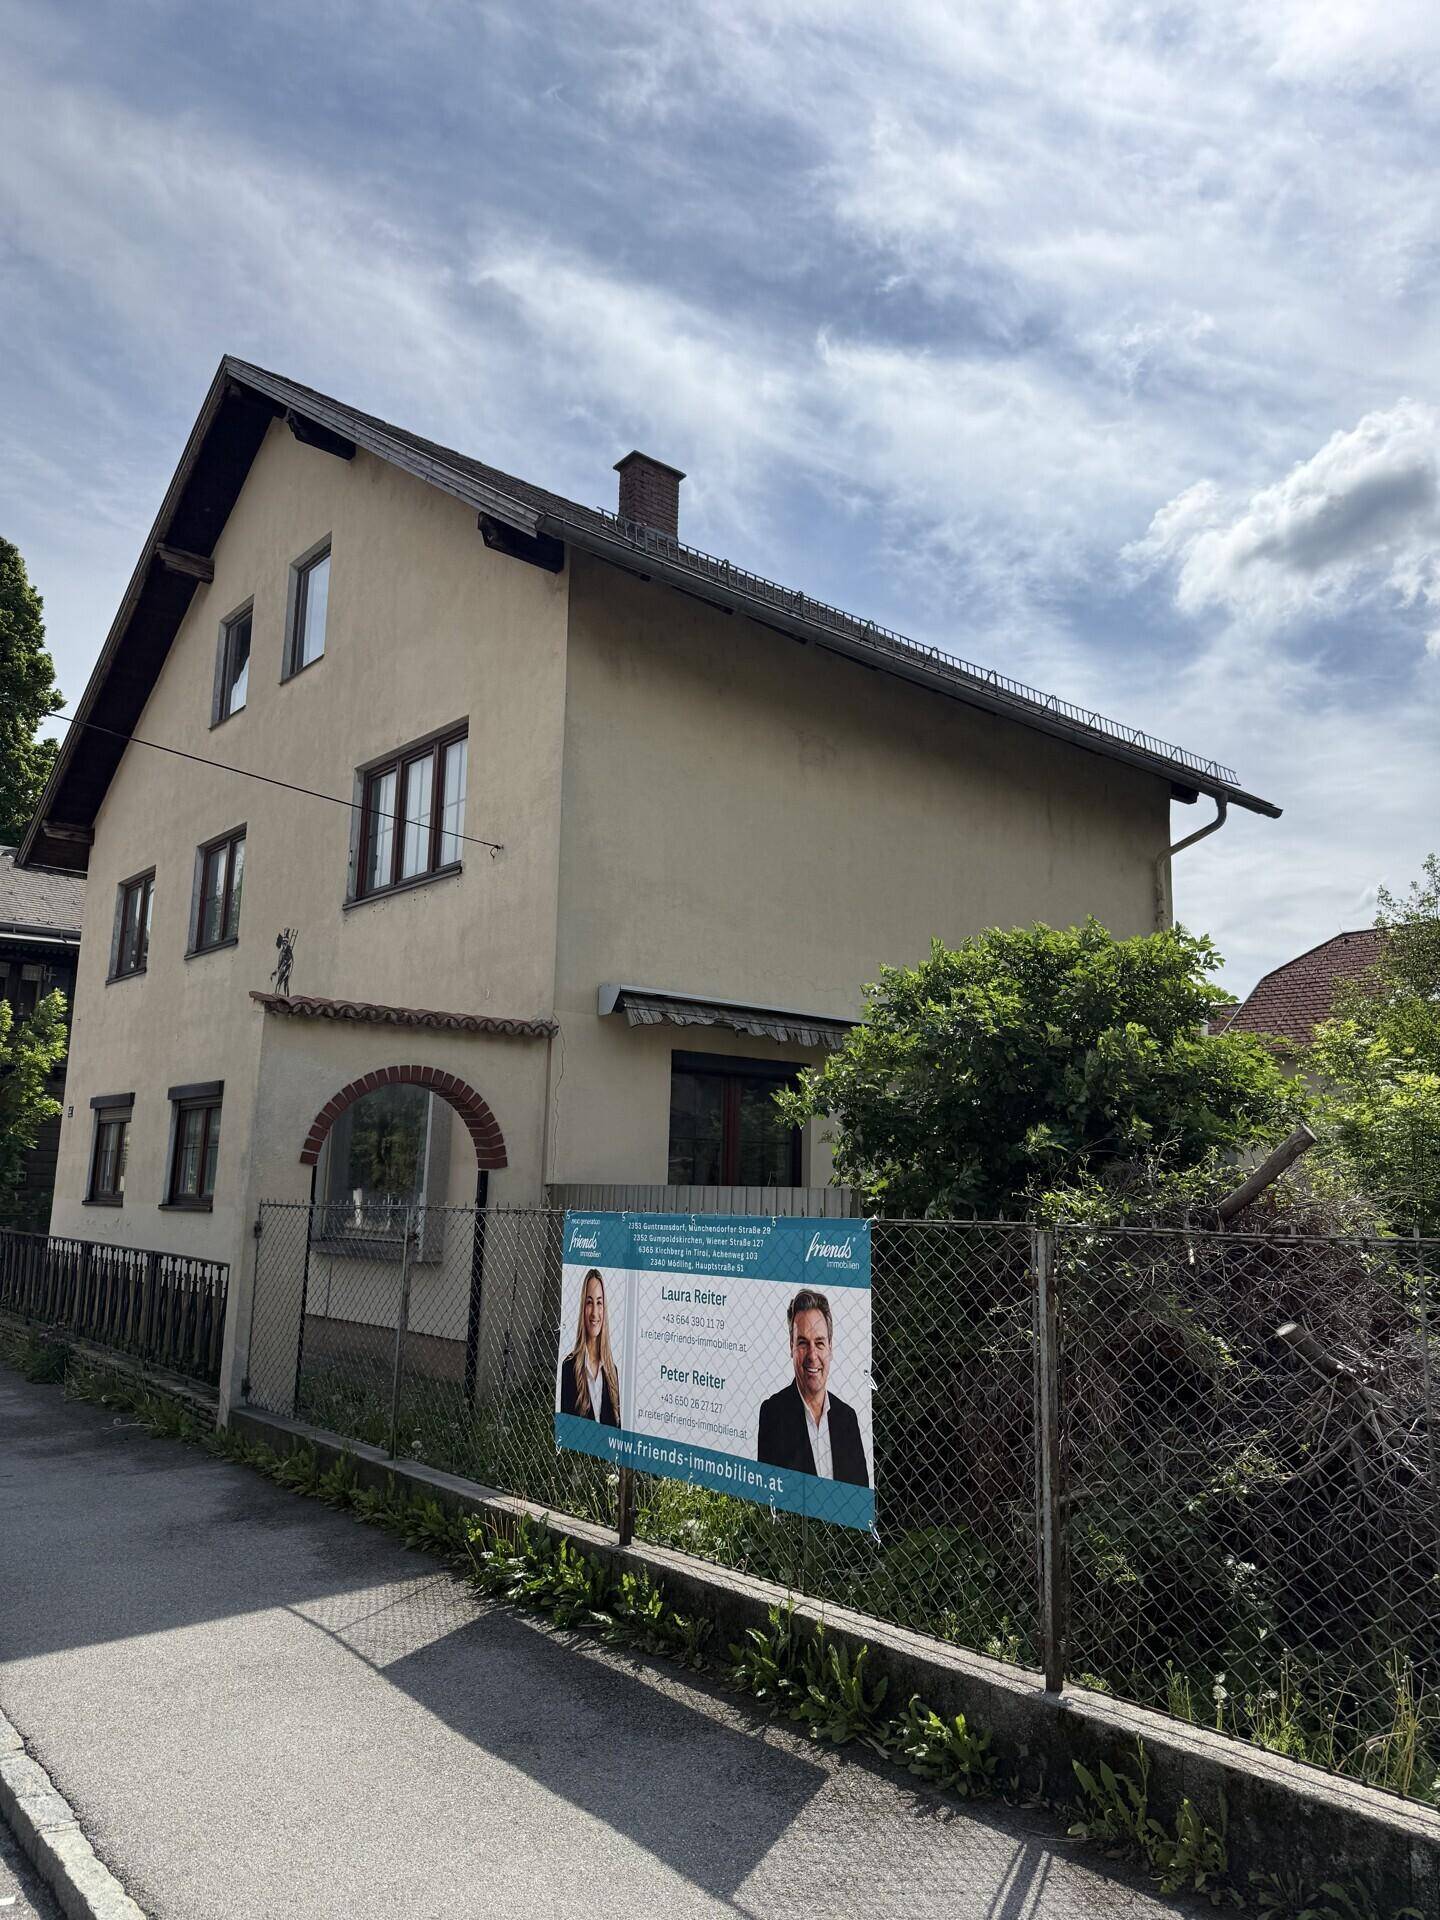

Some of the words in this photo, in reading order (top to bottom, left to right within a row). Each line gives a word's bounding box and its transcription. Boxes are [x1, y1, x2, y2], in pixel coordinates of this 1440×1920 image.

[643, 1223, 687, 1232] Guntramsdorf,
[738, 1226, 761, 1234] Straße
[568, 1227, 598, 1253] friends
[633, 1234, 648, 1242] 2352
[649, 1235, 705, 1246] Gumpoldskirchen,
[706, 1238, 729, 1246] Wiener
[730, 1238, 751, 1247] Straße
[752, 1239, 764, 1247] 127
[804, 1231, 852, 1263] friends
[655, 1247, 684, 1257] Kirchberg
[694, 1249, 711, 1258] Tirol,
[712, 1250, 745, 1261] Achenweg
[746, 1252, 758, 1260] 103
[650, 1258, 666, 1266] 2340
[667, 1259, 694, 1269] Mödling,
[696, 1262, 736, 1272] Hauptstraße
[737, 1264, 744, 1272] 51
[826, 1259, 860, 1270] immobilien
[661, 1286, 691, 1303] Laura
[694, 1289, 727, 1306] Reiter
[662, 1313, 675, 1325] +43
[676, 1314, 690, 1326] 664
[691, 1316, 705, 1328] 390
[706, 1318, 714, 1329] 11
[715, 1319, 725, 1330] 79
[660, 1365, 690, 1383] Peter
[692, 1370, 726, 1390] Reiter
[661, 1393, 673, 1405] +43
[674, 1395, 688, 1407] 650
[690, 1398, 700, 1409] 26
[700, 1400, 709, 1411] 27
[710, 1402, 723, 1414] 127
[637, 1408, 748, 1440] p.reiter@friends-immobilien.at
[608, 1436, 784, 1493] www.friends-immobilien.at
